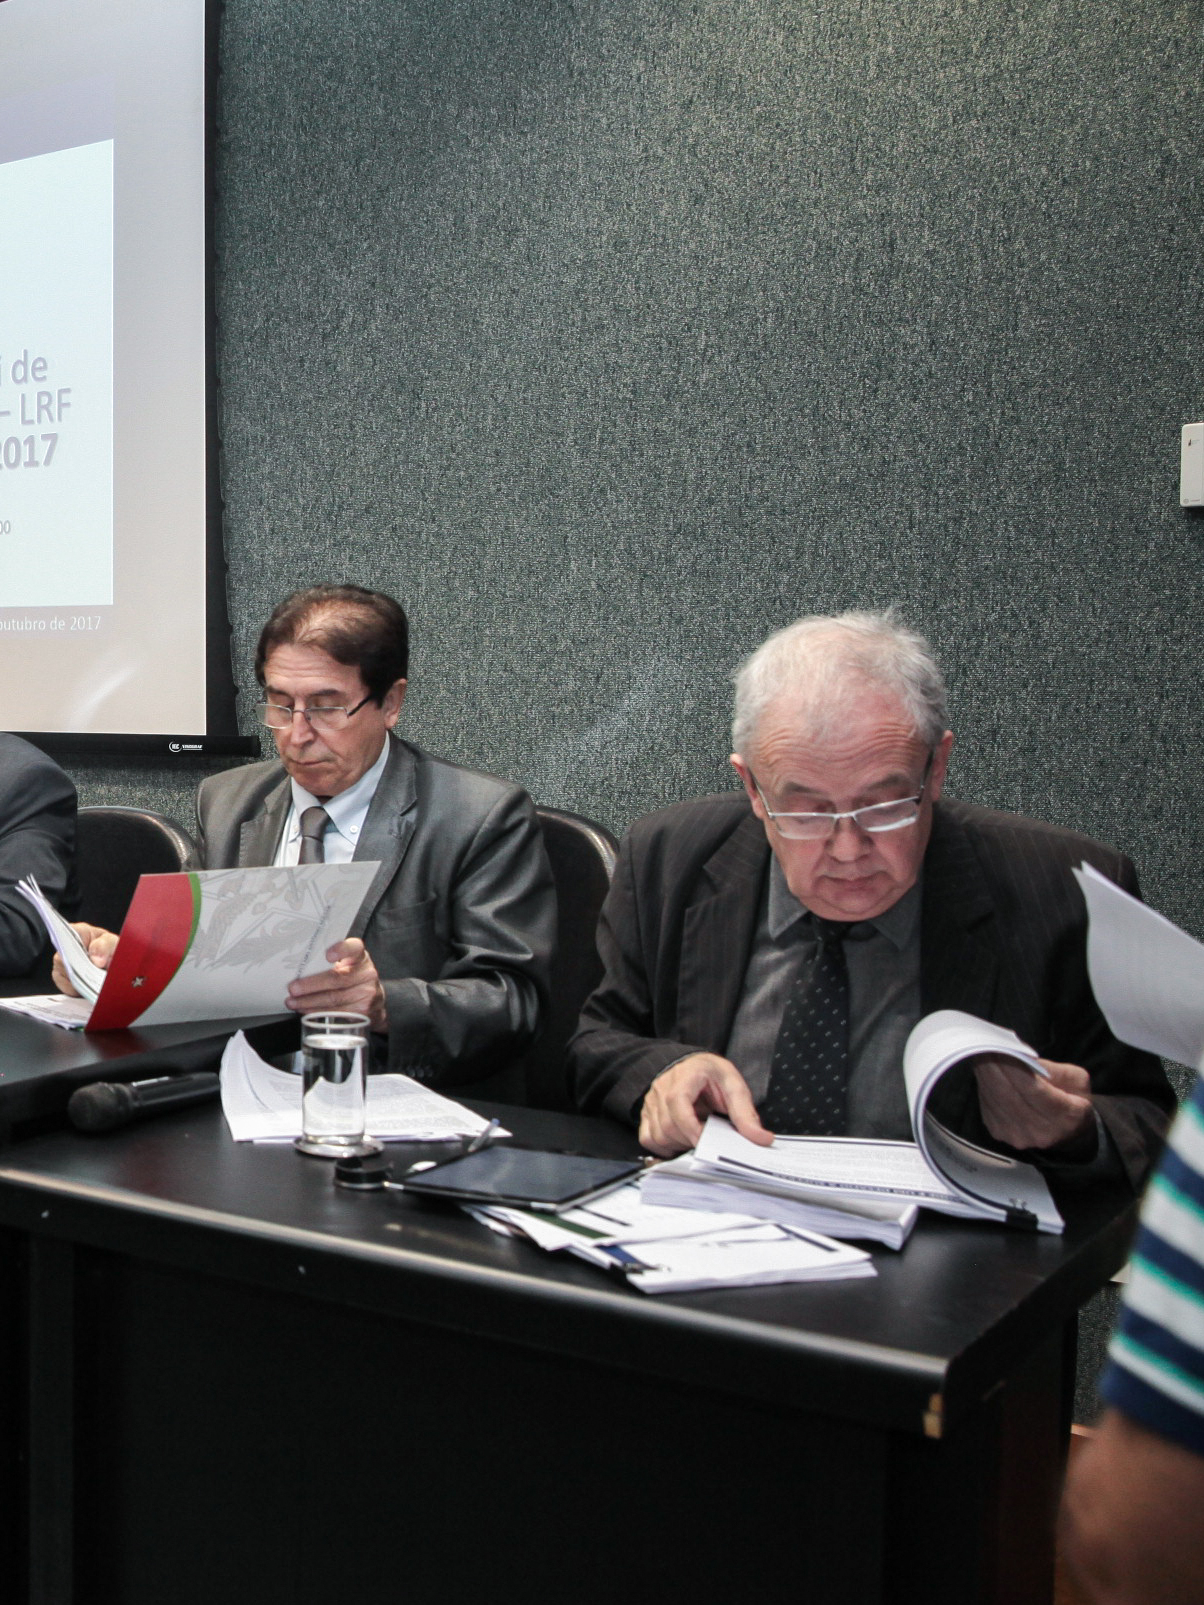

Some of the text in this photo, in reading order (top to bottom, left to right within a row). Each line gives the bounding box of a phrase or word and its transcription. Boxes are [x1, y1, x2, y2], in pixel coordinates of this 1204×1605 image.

[11, 349, 48, 385] de
[20, 388, 72, 426] LRF
[50, 616, 66, 631] de
[70, 615, 102, 631] 2017
